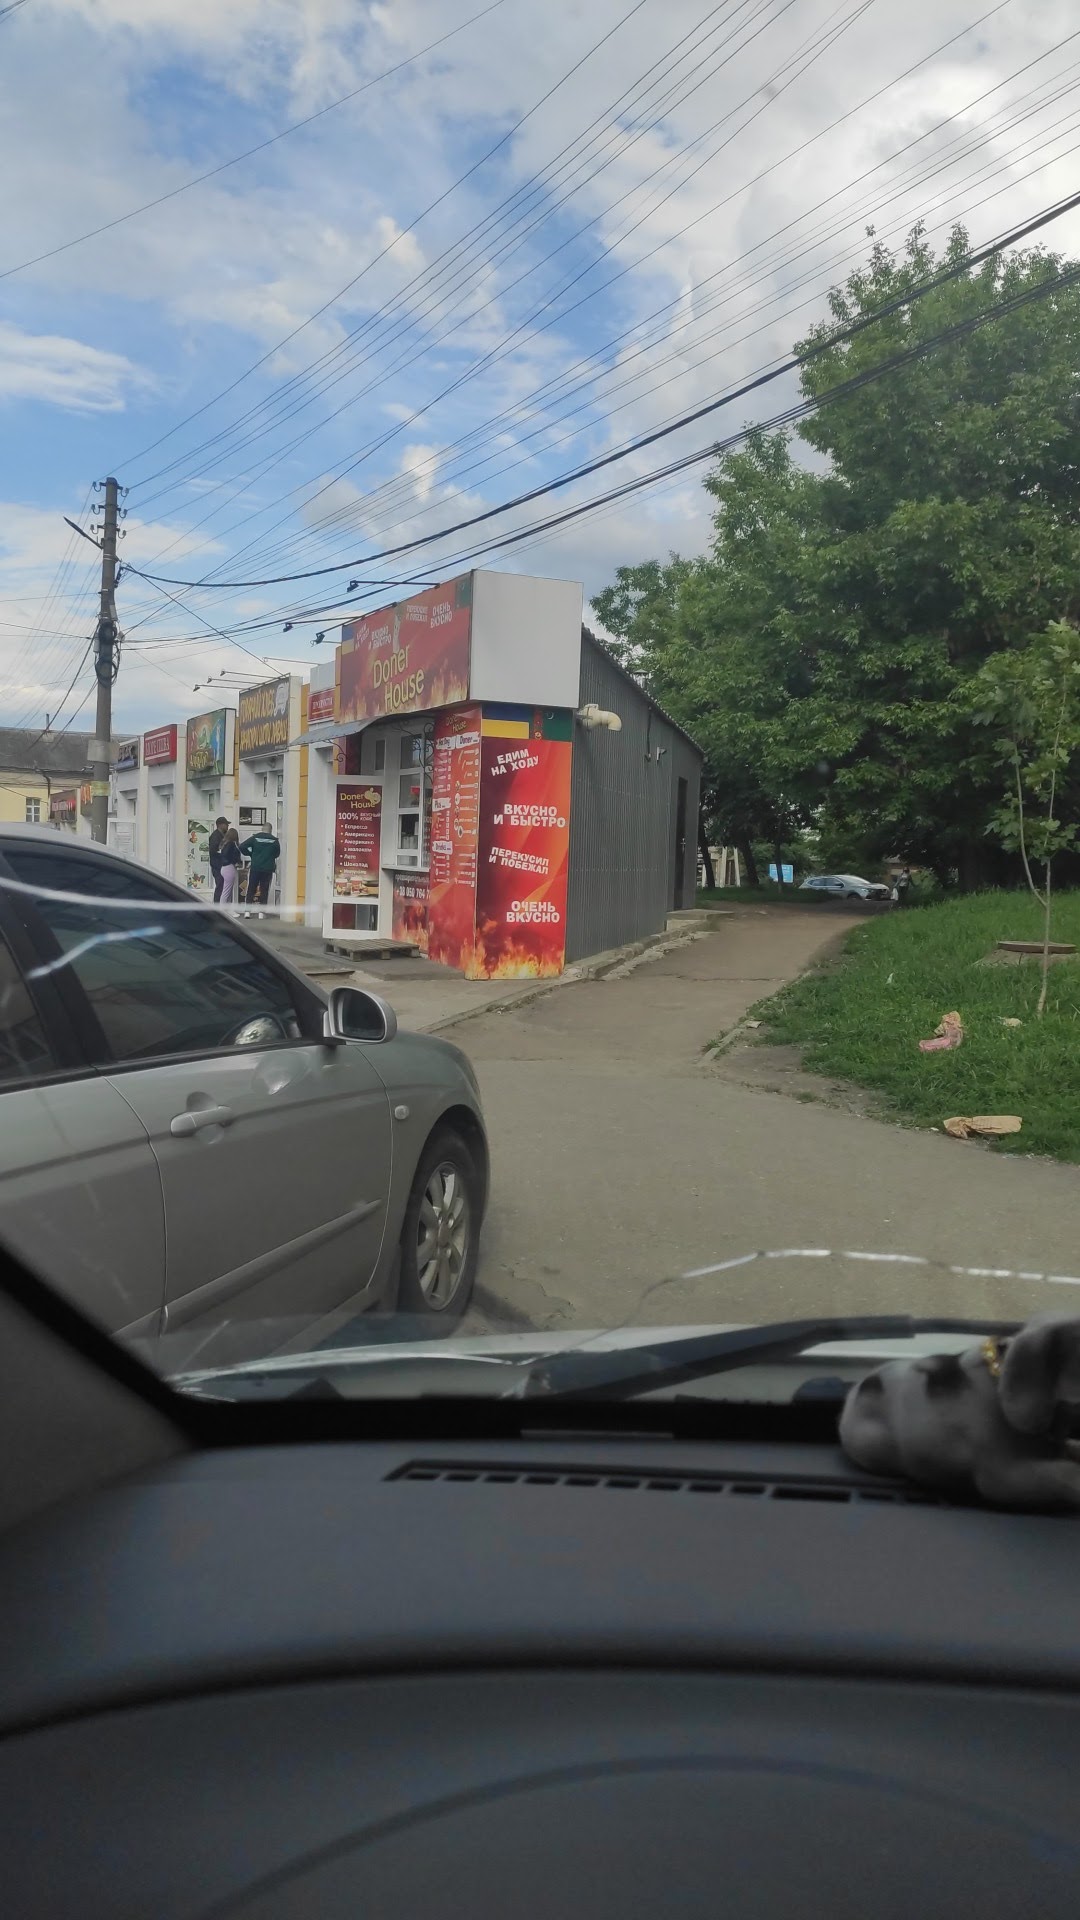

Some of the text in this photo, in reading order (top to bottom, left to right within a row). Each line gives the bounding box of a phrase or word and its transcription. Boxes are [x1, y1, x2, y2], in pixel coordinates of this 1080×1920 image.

[432, 601, 451, 618] ОЧЕНЬ
[430, 610, 453, 629] ВКУСНО
[374, 644, 410, 689] Doner
[384, 668, 425, 714] House
[497, 748, 529, 765] ЕДИМ
[491, 755, 539, 777] НА ХОДУ
[340, 792, 365, 801] Doner
[350, 800, 376, 809] House
[338, 812, 359, 821] 100%
[503, 803, 558, 817] ВКУСНО
[493, 813, 566, 828] И БЫСТРО
[488, 854, 549, 875] И ПОБЕЖАЛ
[491, 846, 550, 867] ПЕРЕКУСИЛ
[511, 900, 556, 912] ОЧЕНЬ
[506, 911, 560, 923] ВКУСНО
